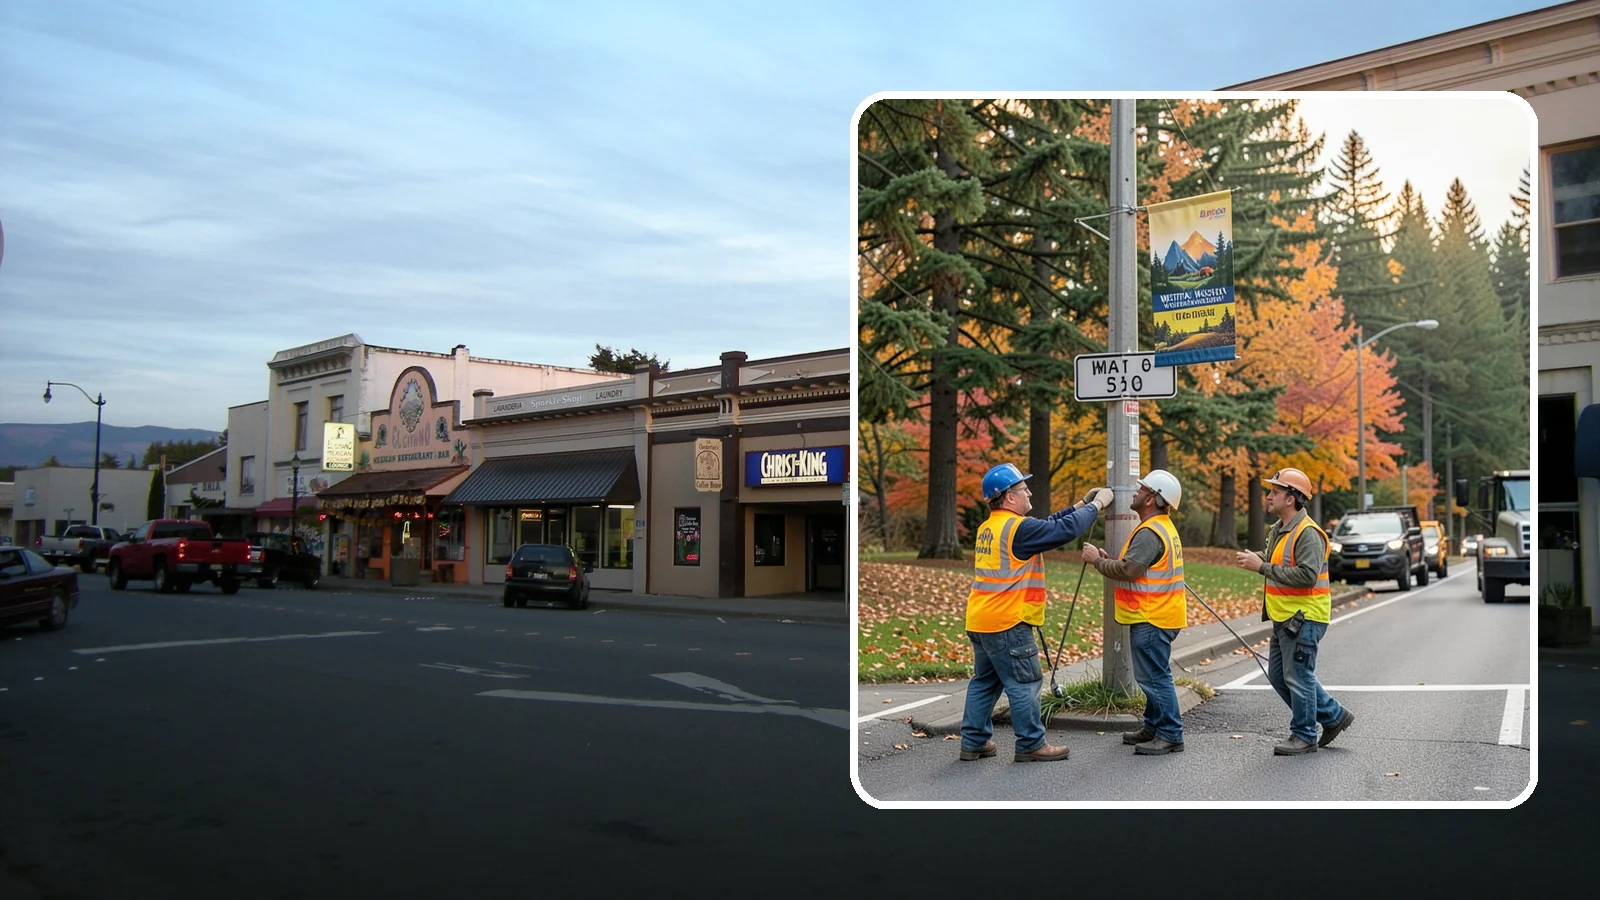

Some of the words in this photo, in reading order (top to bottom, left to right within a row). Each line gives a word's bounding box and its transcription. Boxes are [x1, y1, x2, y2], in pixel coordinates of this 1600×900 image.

[561, 394, 583, 406] Shop
[595, 389, 623, 400] LAUNDRY
[493, 401, 523, 413] LAVANDERIA
[373, 455, 396, 464] MEXICAN
[397, 451, 434, 462] RESTAURANT
[437, 450, 450, 458] BAR
[761, 452, 797, 478] CHRIST
[799, 450, 827, 476] KING
